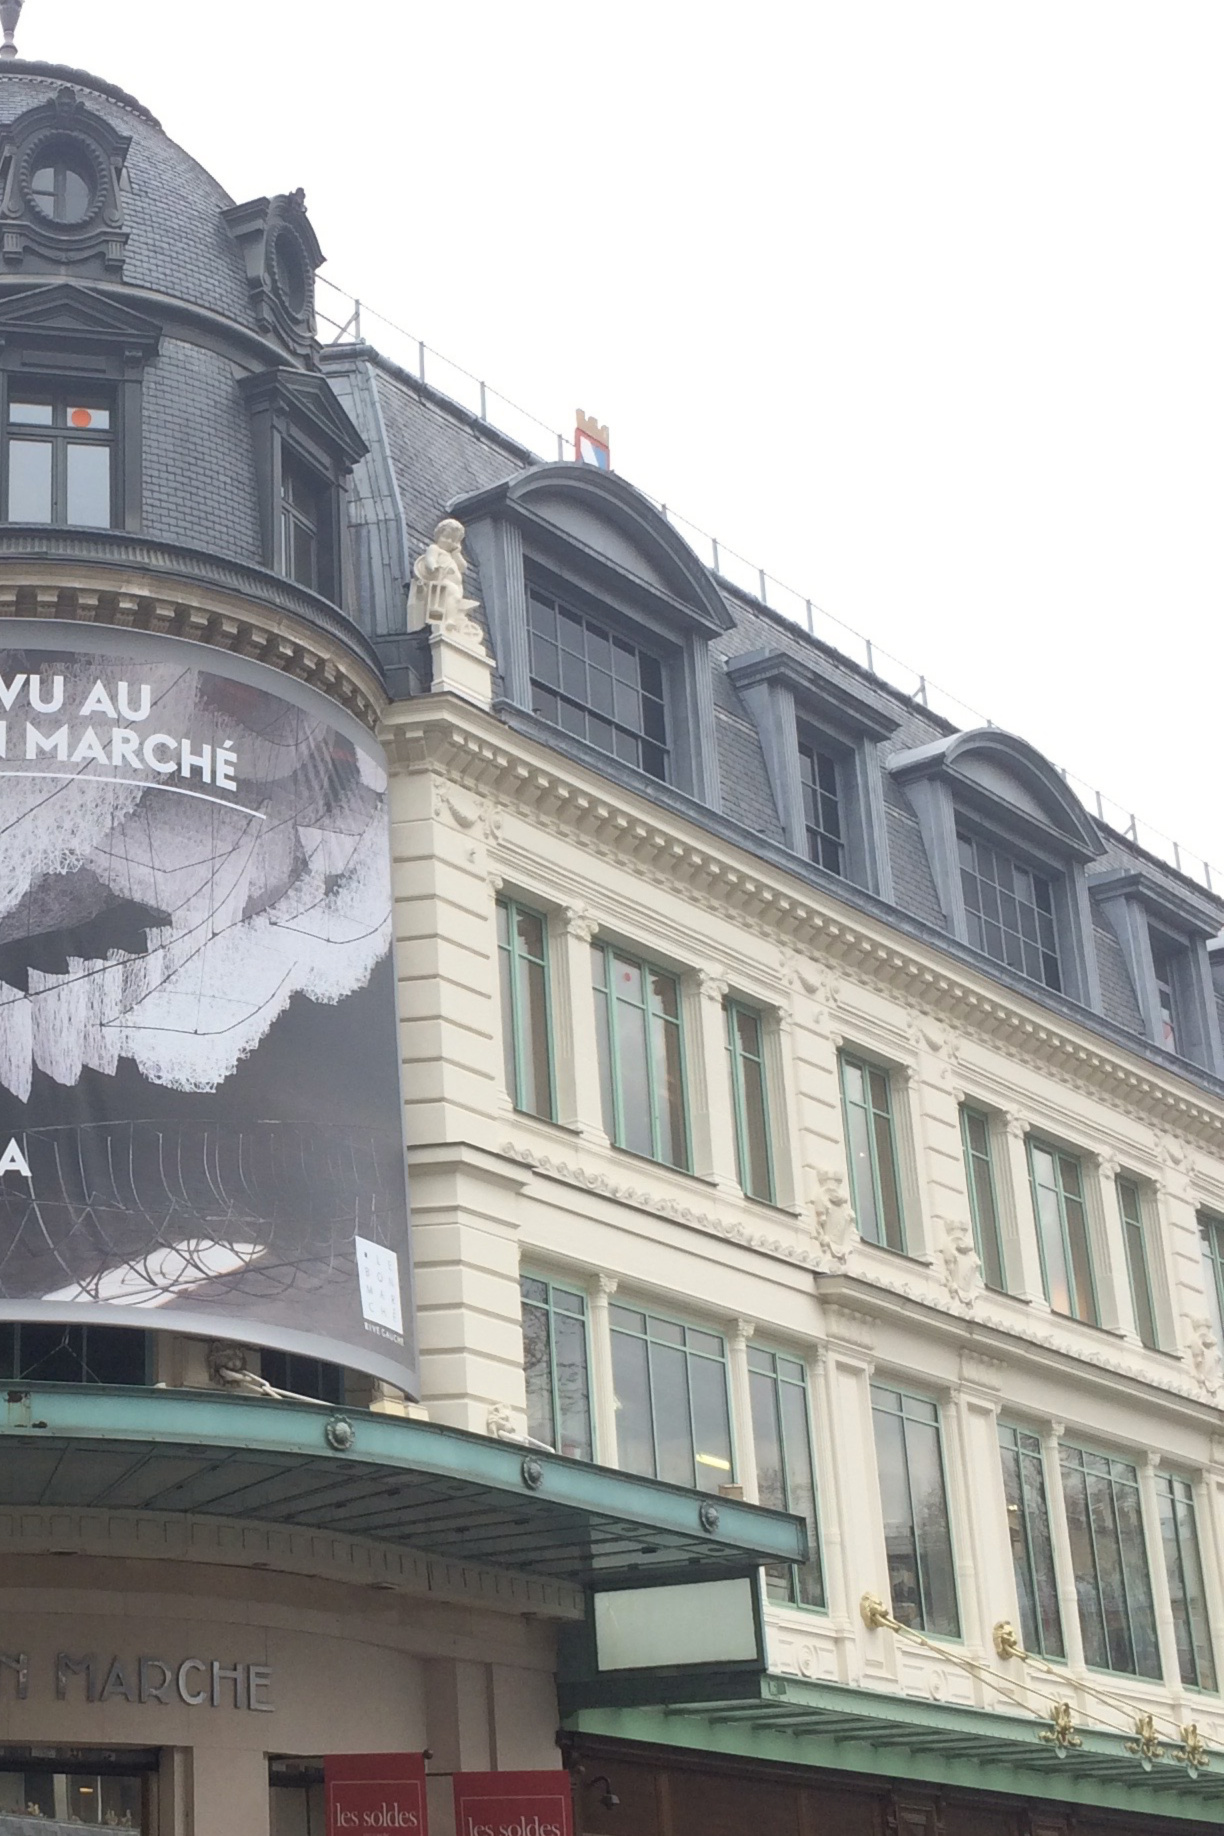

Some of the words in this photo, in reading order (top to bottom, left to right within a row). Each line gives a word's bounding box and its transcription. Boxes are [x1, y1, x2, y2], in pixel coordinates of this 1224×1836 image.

[79, 680, 151, 721] AU
[26, 721, 238, 792] MARCHÉ
[56, 1651, 276, 1713] MARCHE
[336, 1803, 359, 1827] les
[363, 1802, 418, 1827] soldes
[468, 1816, 494, 1836] les
[499, 1815, 560, 1836] soldes
